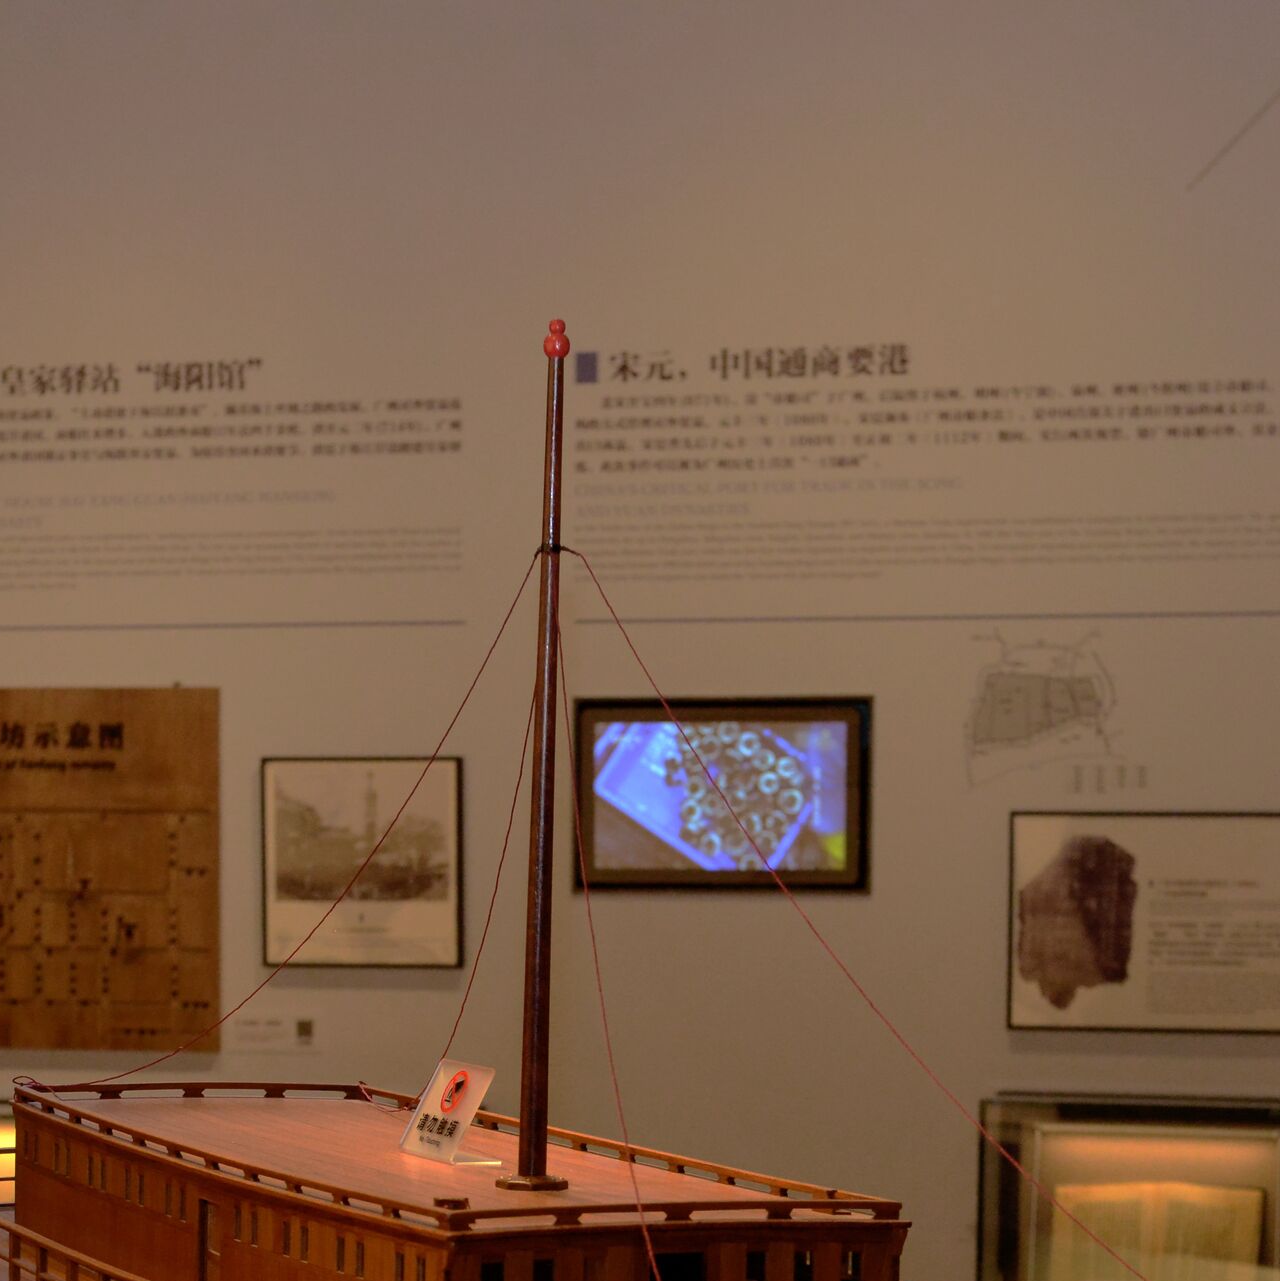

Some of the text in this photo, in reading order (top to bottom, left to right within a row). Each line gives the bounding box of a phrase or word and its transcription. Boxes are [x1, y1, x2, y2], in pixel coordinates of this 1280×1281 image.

[608, 342, 911, 385] 宋元，中国通商要港
[416, 1112, 459, 1138] 请勿触摸
